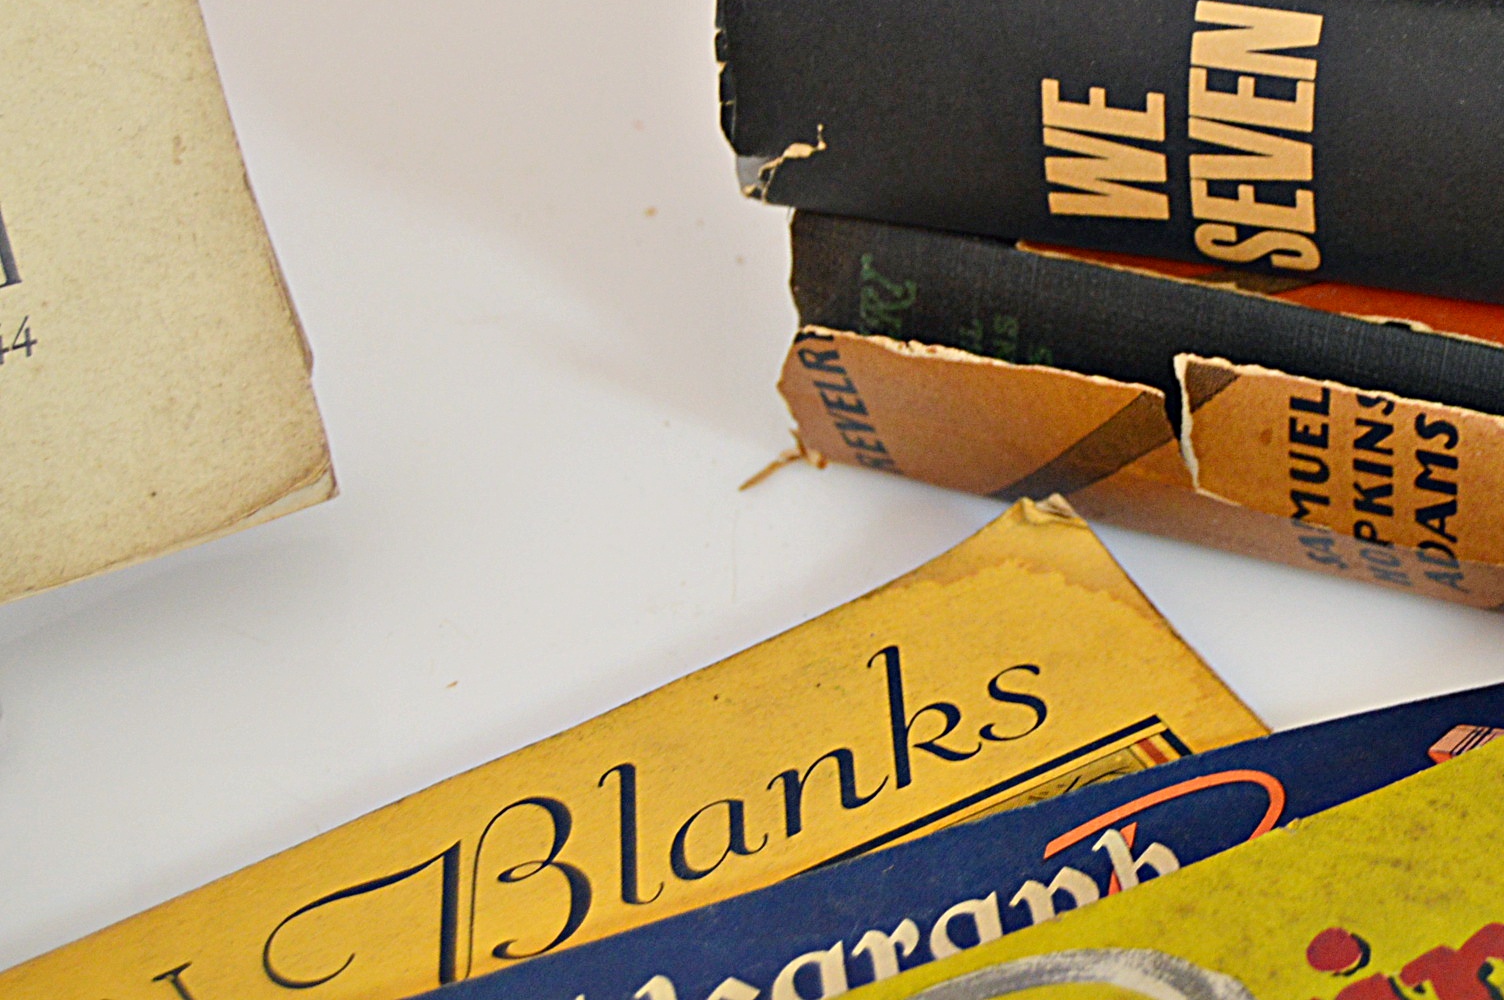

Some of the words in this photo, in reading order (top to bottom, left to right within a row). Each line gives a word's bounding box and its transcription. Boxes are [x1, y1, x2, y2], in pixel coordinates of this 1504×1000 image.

[1041, 78, 1169, 220] WE
[1188, 0, 1323, 271] SEVEN
[1414, 412, 1471, 593] ADAMS
[262, 645, 1049, 990] Blanks
